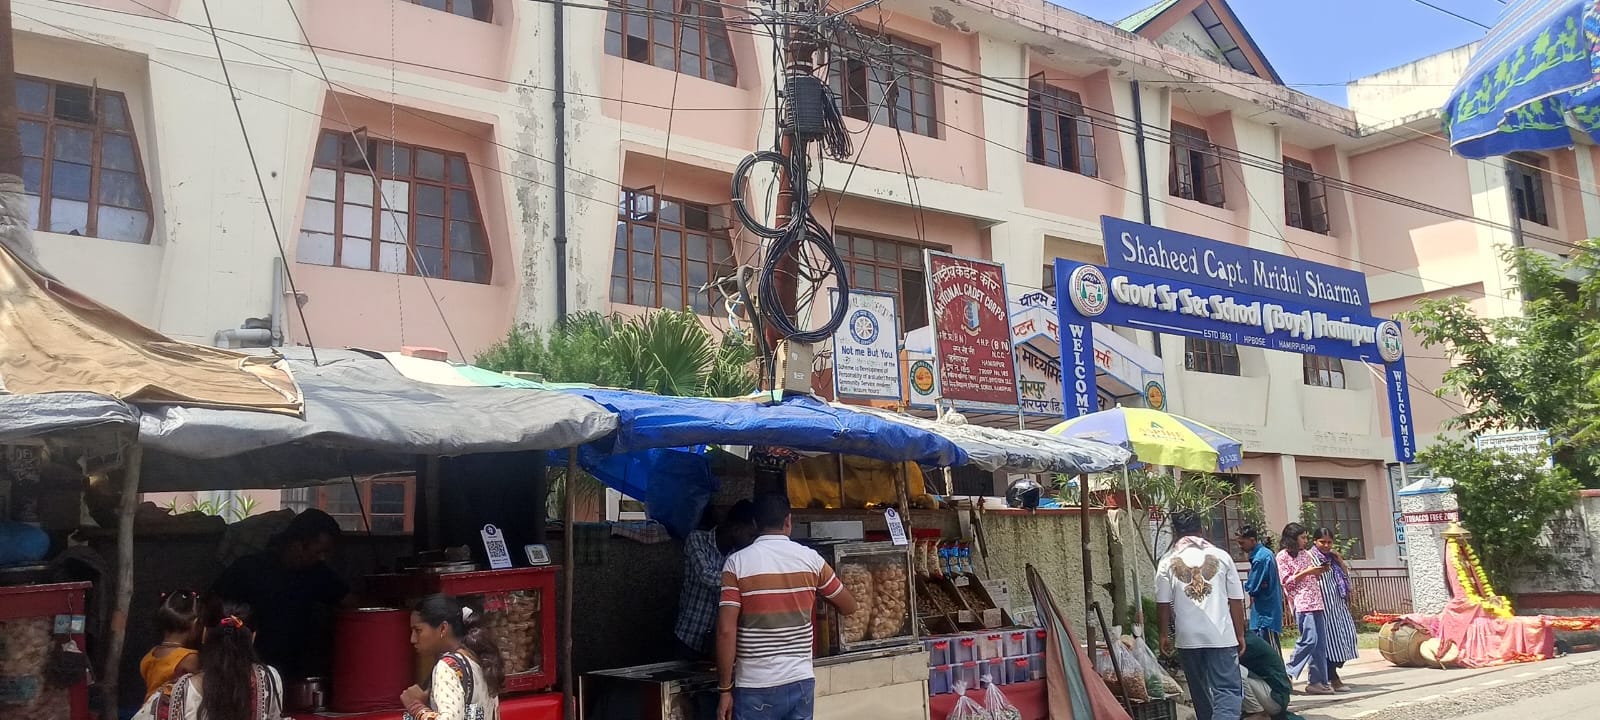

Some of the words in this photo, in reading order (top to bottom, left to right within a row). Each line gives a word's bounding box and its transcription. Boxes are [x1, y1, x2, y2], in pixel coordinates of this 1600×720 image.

[1121, 232, 1199, 275] Shaheed
[1204, 250, 1248, 287] Capt.
[1252, 259, 1302, 294] Mridul
[1305, 271, 1362, 306] Sharma
[935, 283, 963, 317] NATIONAL
[963, 283, 985, 302] CADET
[984, 296, 1005, 321] CORPS
[1111, 276, 1157, 308] Govt
[1157, 285, 1178, 312] Sr
[1178, 289, 1209, 318] Sec
[1208, 295, 1262, 326] School
[1263, 303, 1312, 340] (Boys)
[1012, 320, 1036, 336] प्टन
[1203, 329, 1218, 339] ESTD
[1219, 331, 1232, 341] 1863
[1243, 335, 1266, 346] HPBOSE
[841, 345, 854, 356] Not
[855, 348, 865, 357] me
[867, 348, 879, 358] But
[881, 349, 893, 359] You
[1095, 348, 1111, 368] र्मा
[1068, 323, 1089, 417] WELCOME
[1392, 370, 1410, 458] WELCOMES
